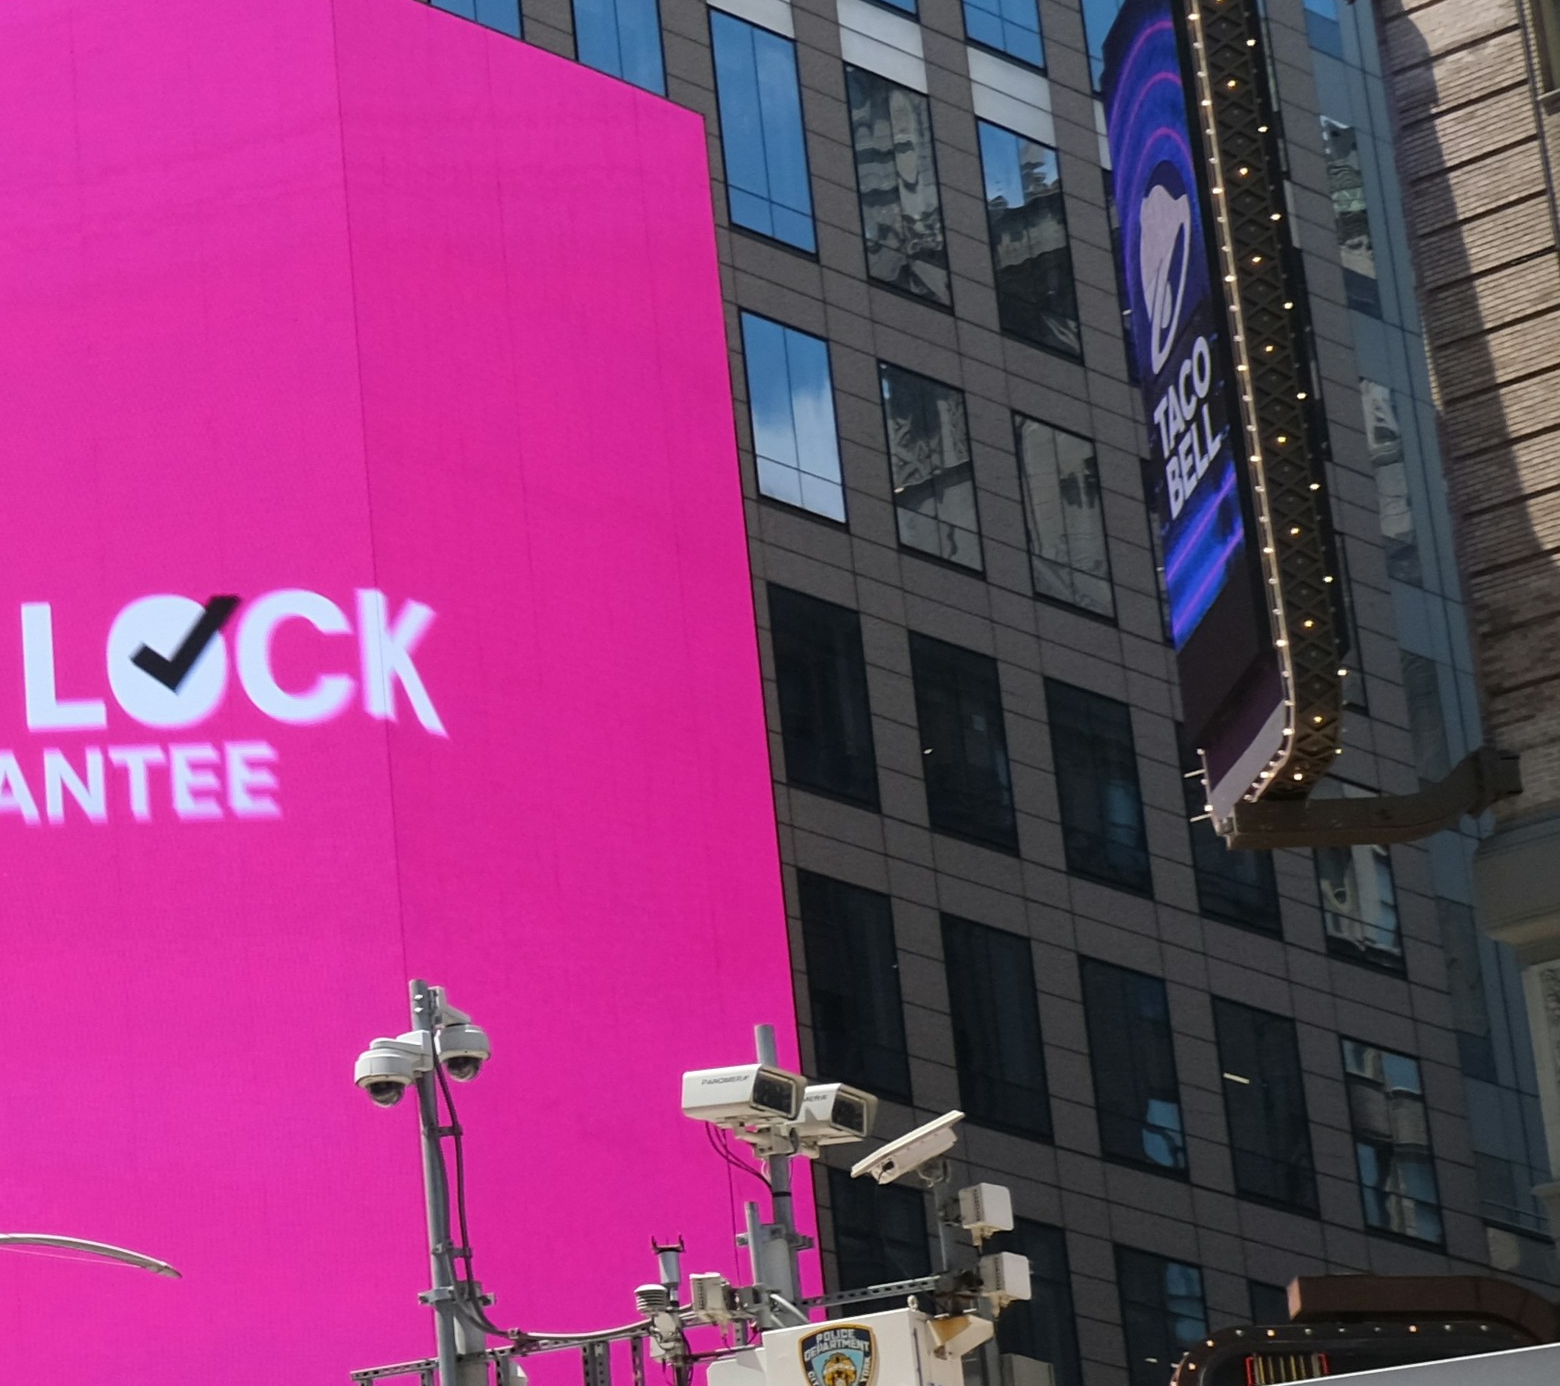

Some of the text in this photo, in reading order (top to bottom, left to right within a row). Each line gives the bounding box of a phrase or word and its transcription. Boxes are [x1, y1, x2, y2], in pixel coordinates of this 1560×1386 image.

[1153, 335, 1212, 459] TACO
[1165, 402, 1222, 521] BELL
[20, 587, 450, 741] LOCK
[804, 1338, 870, 1362] DEPARTMENT
[816, 1329, 856, 1343] POLICE
